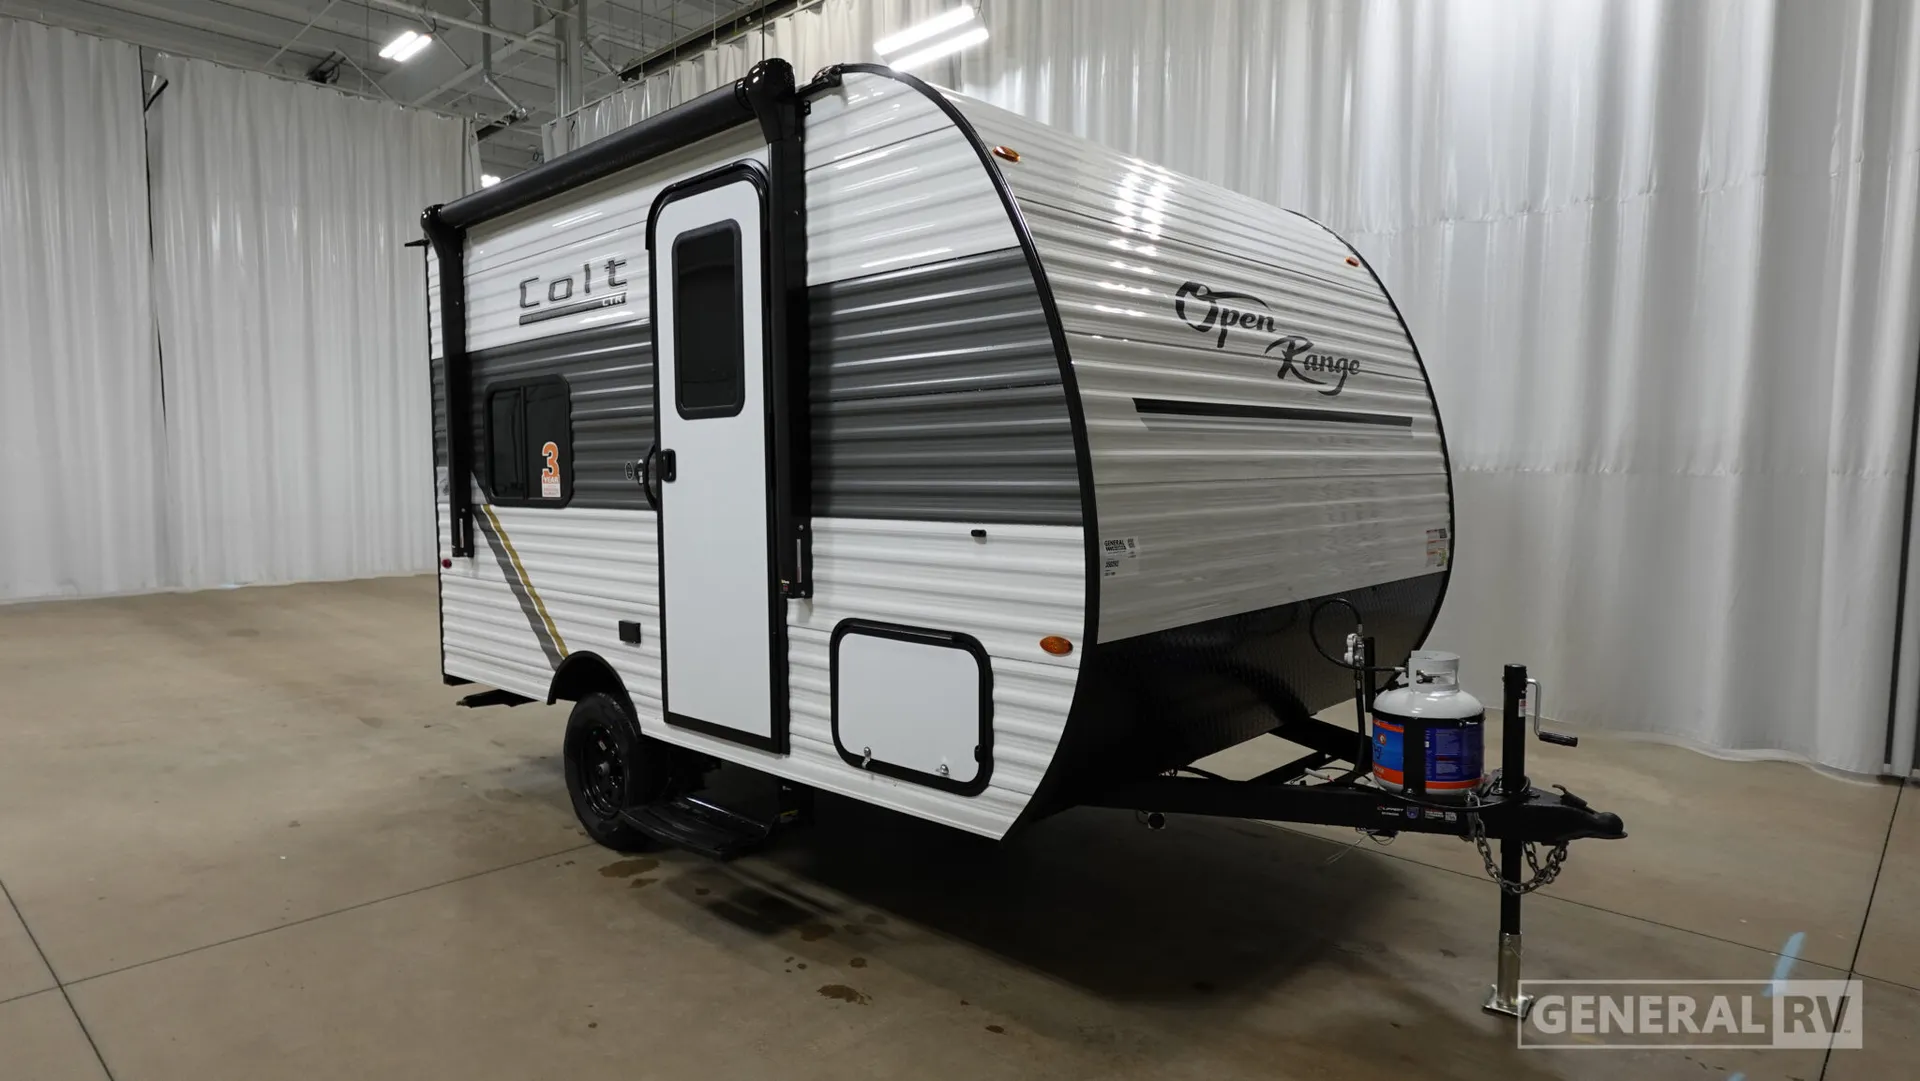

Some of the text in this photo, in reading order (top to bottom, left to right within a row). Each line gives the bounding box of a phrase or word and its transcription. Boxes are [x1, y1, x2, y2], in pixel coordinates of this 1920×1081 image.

[519, 259, 627, 308] Colt
[1175, 281, 1277, 348] Open
[1264, 335, 1360, 396] Range
[542, 441, 560, 477] 3
[1104, 539, 1125, 547] GENERAL
